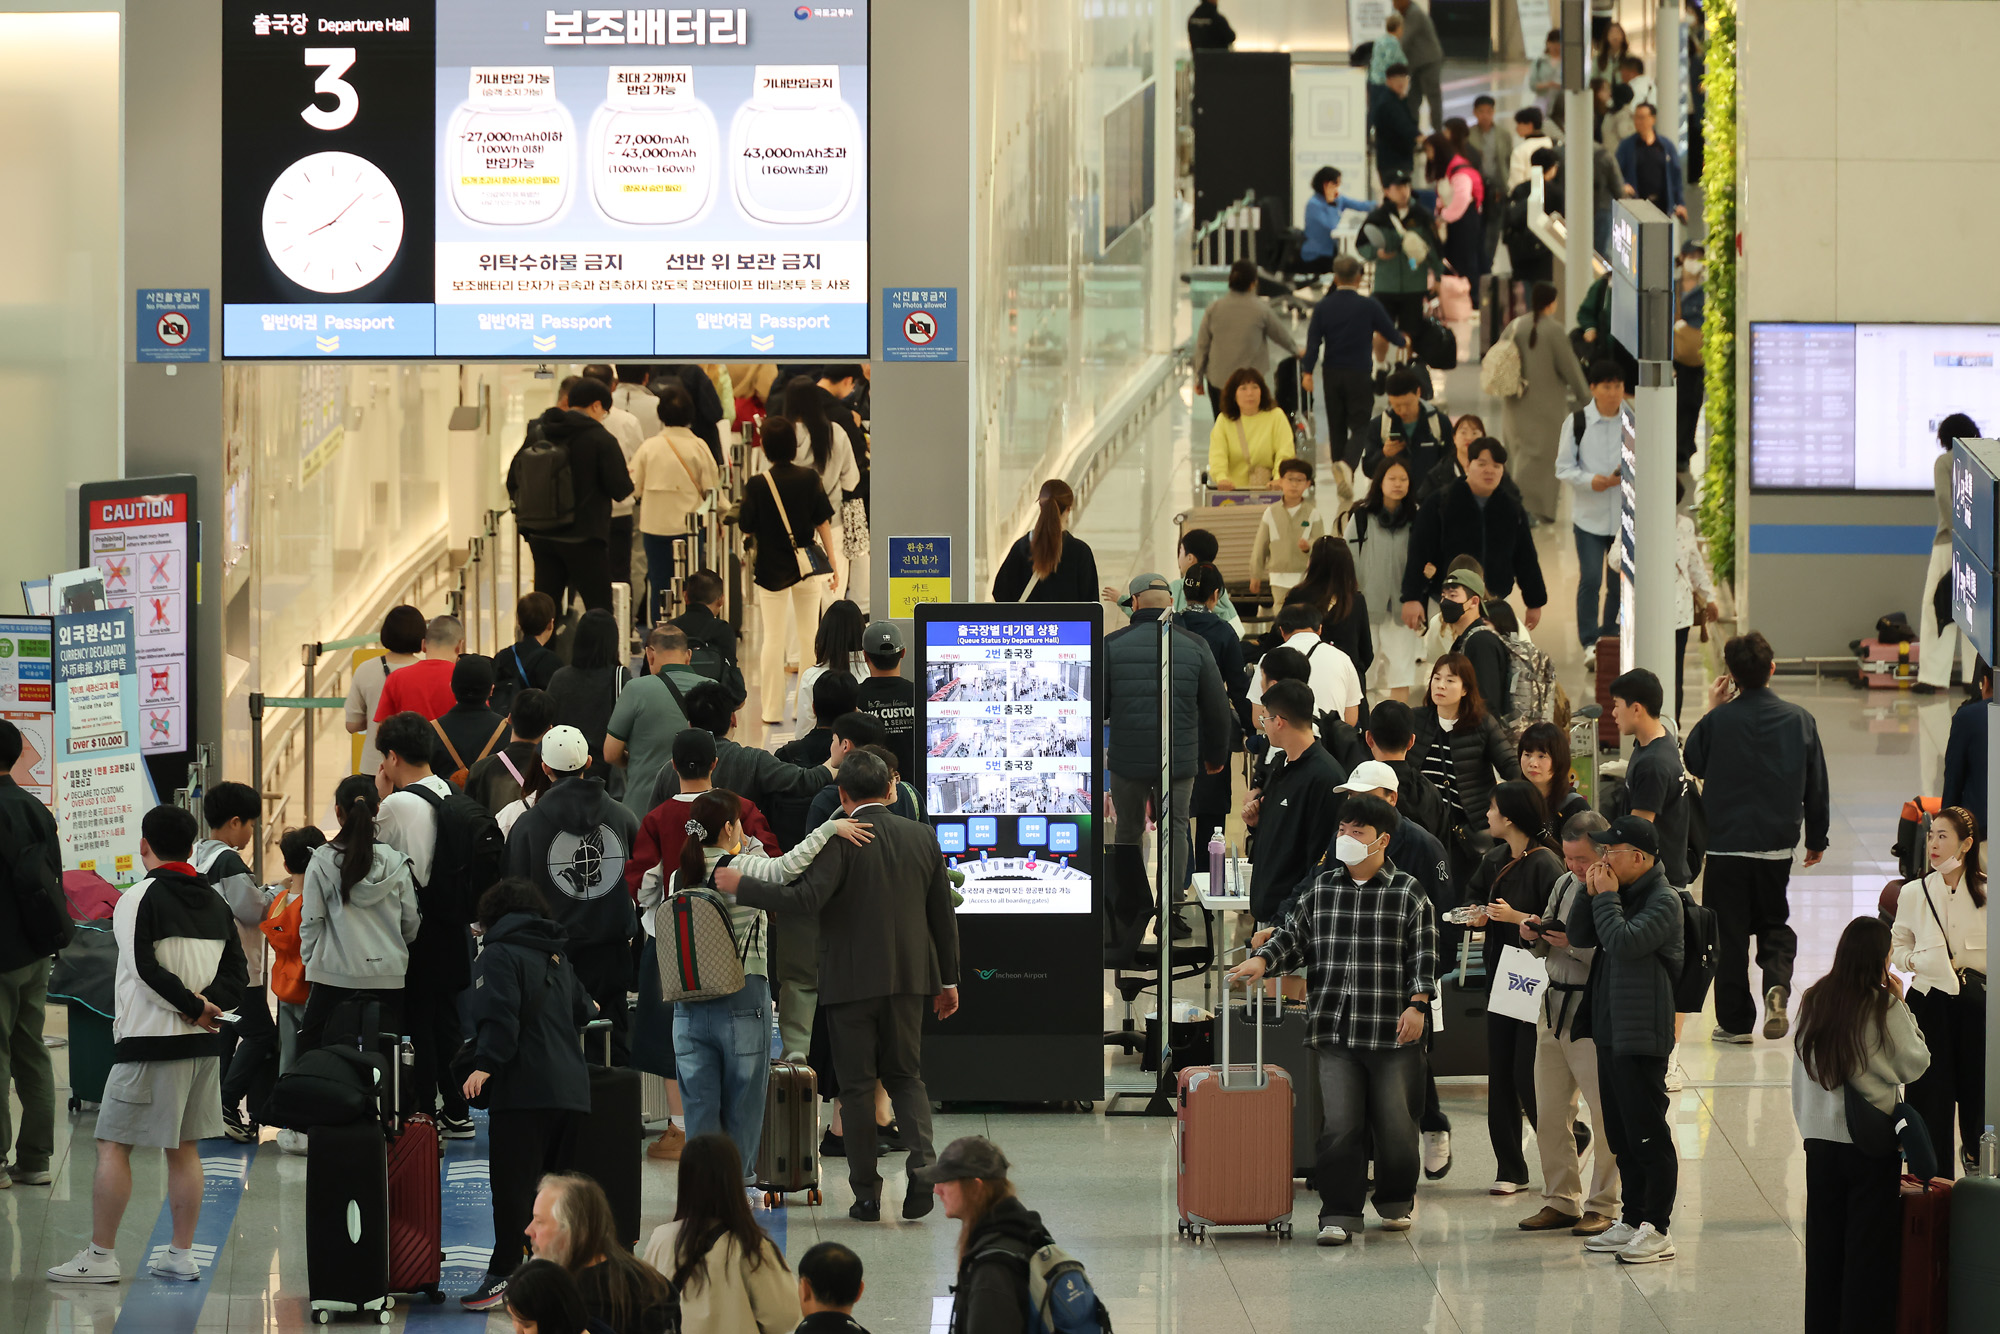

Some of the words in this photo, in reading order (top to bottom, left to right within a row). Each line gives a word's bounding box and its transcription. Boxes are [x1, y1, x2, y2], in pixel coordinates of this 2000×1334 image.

[252, 14, 309, 35] 출국장
[318, 18, 383, 35] Departure
[386, 17, 410, 32] Hall
[544, 8, 747, 45] 보조배터리
[476, 74, 498, 84] 기내
[501, 74, 524, 84] 반입
[528, 74, 550, 84] 가능
[617, 73, 640, 83] 최대
[643, 73, 686, 83] 2개까지
[762, 78, 832, 89] 기내반입금지
[300, 48, 360, 131] 3
[482, 88, 502, 96] (승객
[504, 88, 522, 96] 소지
[524, 88, 543, 96] 가능)
[627, 85, 650, 95] 반입
[654, 85, 676, 95] 가능
[459, 132, 563, 143] ~27,000mAh이하
[614, 134, 690, 146] 27,000mAh
[476, 145, 520, 154] (100Wh
[522, 145, 544, 154] 이하)
[621, 148, 697, 160] 43,000mAh
[743, 148, 847, 160] 43,000mAh초과
[486, 158, 534, 170] 반입가능
[762, 165, 828, 175] (160Wh초과)
[479, 254, 578, 271] 위탁수하물
[584, 254, 622, 270] 금지
[666, 254, 705, 270] 선반
[711, 254, 730, 270] 위
[736, 254, 776, 270] 보관
[782, 254, 821, 270] 금지
[453, 280, 514, 291] 보조배터리
[518, 280, 554, 291] 단자가
[558, 280, 594, 291] 금속과
[599, 280, 647, 291] 접촉하지
[651, 280, 688, 291] 않도록
[692, 280, 753, 290] 절연테이프
[758, 280, 806, 290] 비닐봉투
[811, 280, 822, 290] 등
[826, 280, 850, 290] 사용
[892, 291, 947, 302] 사진촬영금지
[261, 314, 317, 331] 일반여권
[325, 314, 395, 332] Passport
[478, 313, 534, 330] 일반여권
[542, 314, 612, 330] Passport
[696, 313, 752, 329] 일반여권
[760, 313, 830, 330] Passport
[102, 500, 173, 522] CAUTION
[907, 542, 934, 552] 환송객
[902, 555, 938, 564] 진입불가
[912, 583, 929, 592] 카트
[59, 620, 126, 645] 외국환신고
[958, 624, 1000, 637] 출국장별
[1003, 624, 1035, 636] 대기열
[1037, 624, 1059, 636] 상황
[957, 637, 980, 645] (Queue
[1002, 637, 1010, 645] by
[1011, 637, 1043, 645] Departure
[1044, 637, 1060, 645] Hall)
[60, 648, 89, 662] CURRENCY
[90, 644, 126, 658] DECLARATION
[985, 649, 1001, 659] 2번
[1004, 649, 1033, 659] 출국장
[881, 707, 914, 718] CUSTO
[985, 705, 1001, 715] 4번
[1004, 705, 1033, 715] 출국장
[73, 740, 89, 750] over
[985, 761, 1001, 771] 5번
[1004, 761, 1033, 771] 출국장
[71, 790, 92, 799] DECLARE
[93, 788, 100, 796] TO
[101, 786, 124, 796] CUSTOMS
[85, 798, 95, 806] USD
[100, 795, 116, 804] 10,000
[1024, 972, 1047, 980] Airport
[1508, 972, 1541, 996] PXG
[488, 1280, 508, 1296] HOKA
